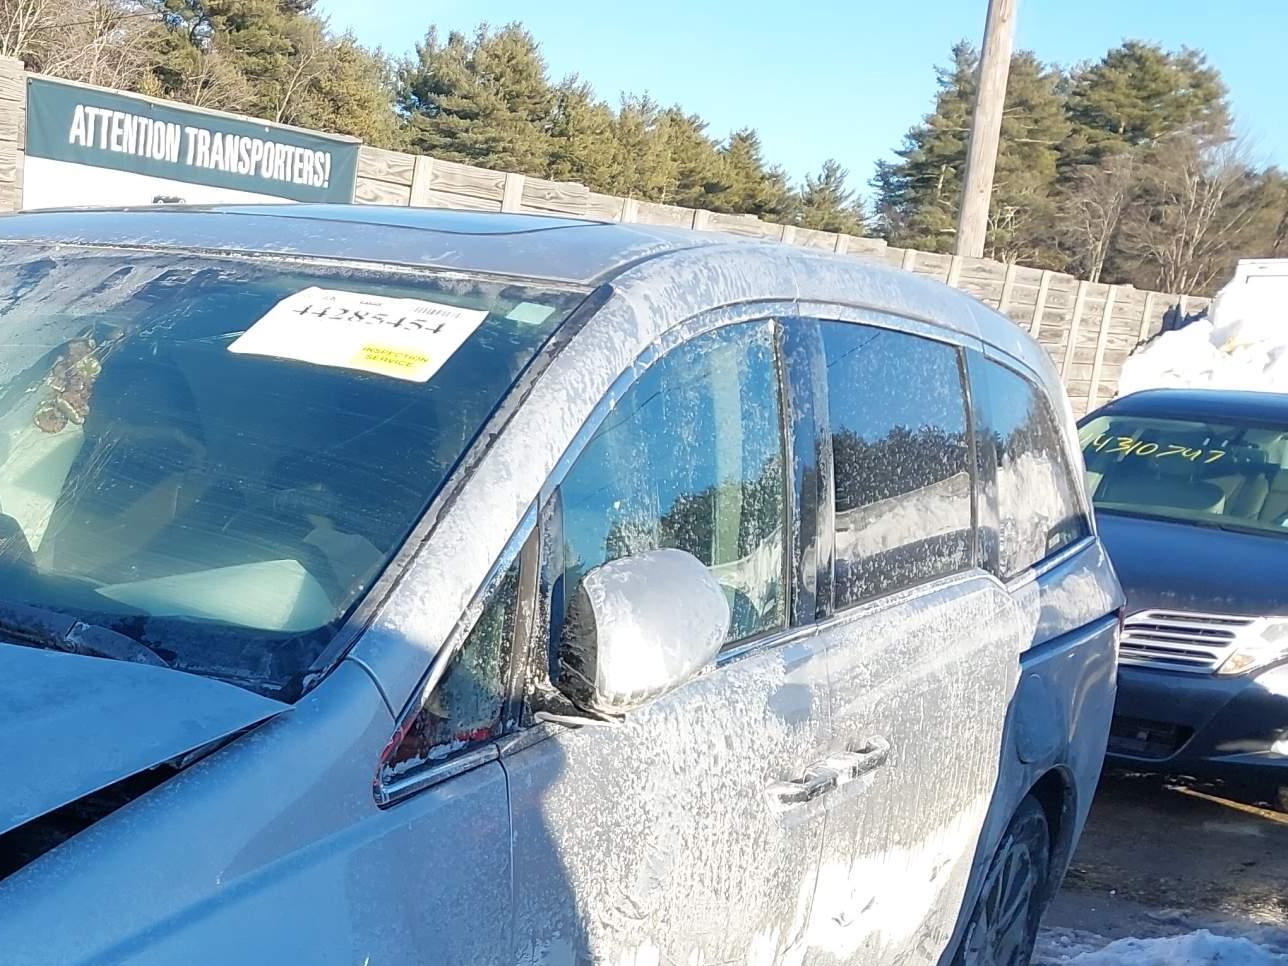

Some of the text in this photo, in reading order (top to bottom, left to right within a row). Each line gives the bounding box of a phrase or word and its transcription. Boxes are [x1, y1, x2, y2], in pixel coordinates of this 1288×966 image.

[69, 104, 331, 188] ATTENTION TRANSPORTERS!
[292, 304, 445, 334] 44285454
[362, 345, 429, 363] INSPECTION
[364, 354, 415, 368] SERVICE
